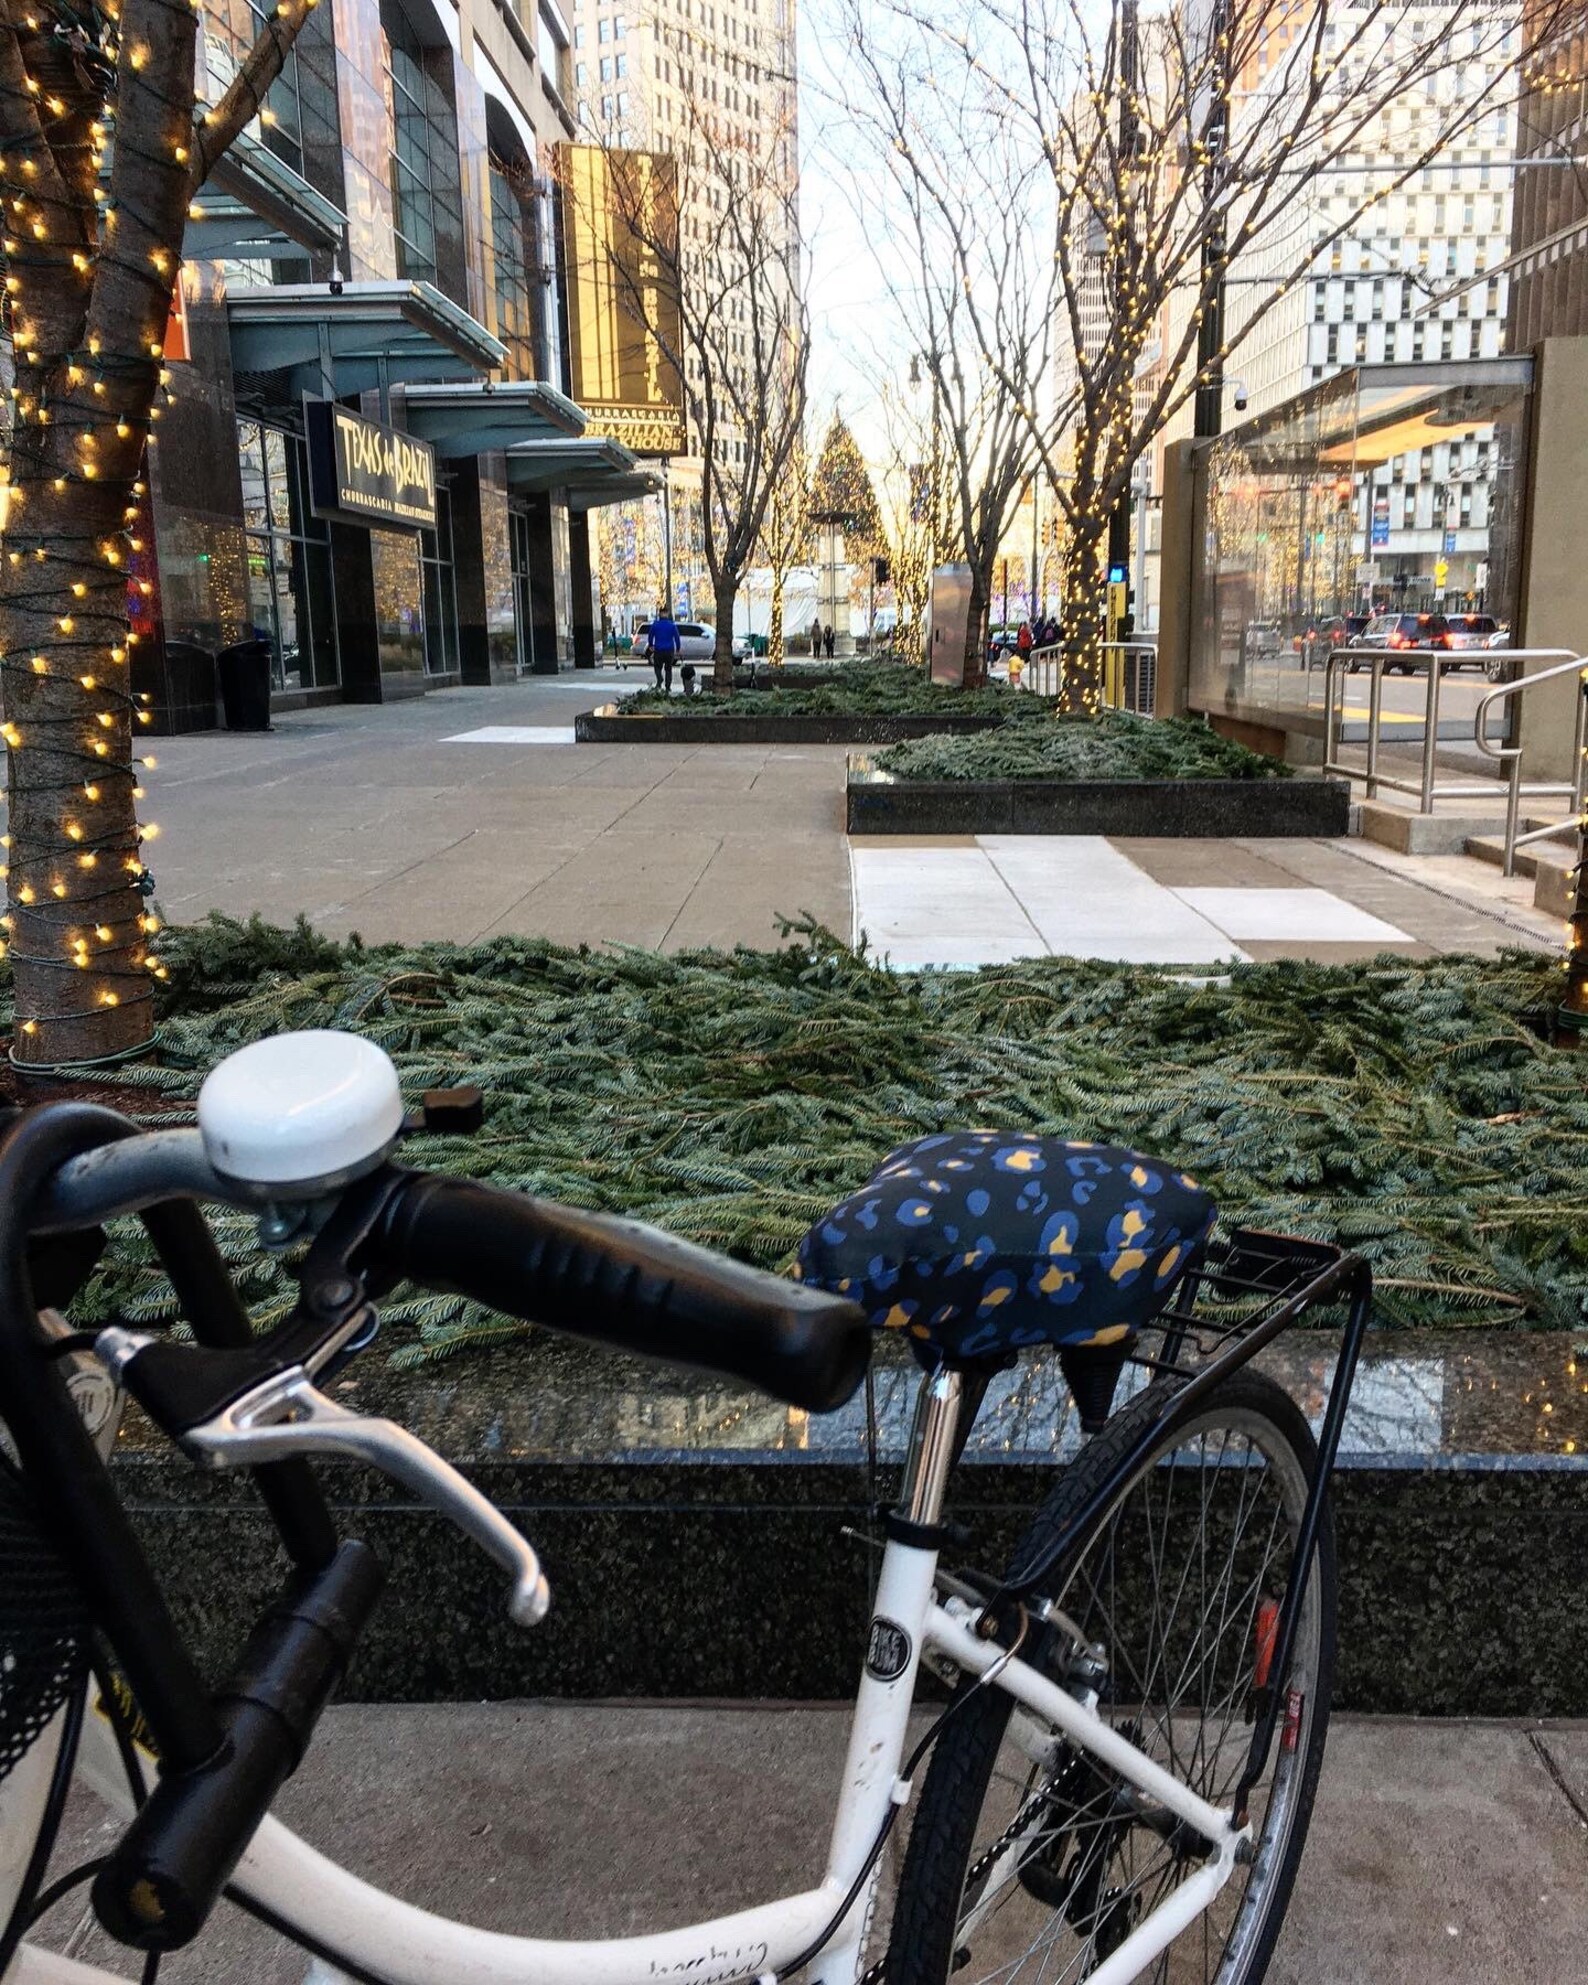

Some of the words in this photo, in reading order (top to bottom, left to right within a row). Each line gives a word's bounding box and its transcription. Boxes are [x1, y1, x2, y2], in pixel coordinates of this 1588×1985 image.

[583, 422, 673, 438] BRAZILIAN
[605, 436, 681, 451] KHOUSE
[336, 414, 381, 485] TEXAS
[393, 434, 435, 507] BRAZIL
[341, 487, 393, 512] CHURRASCARIA
